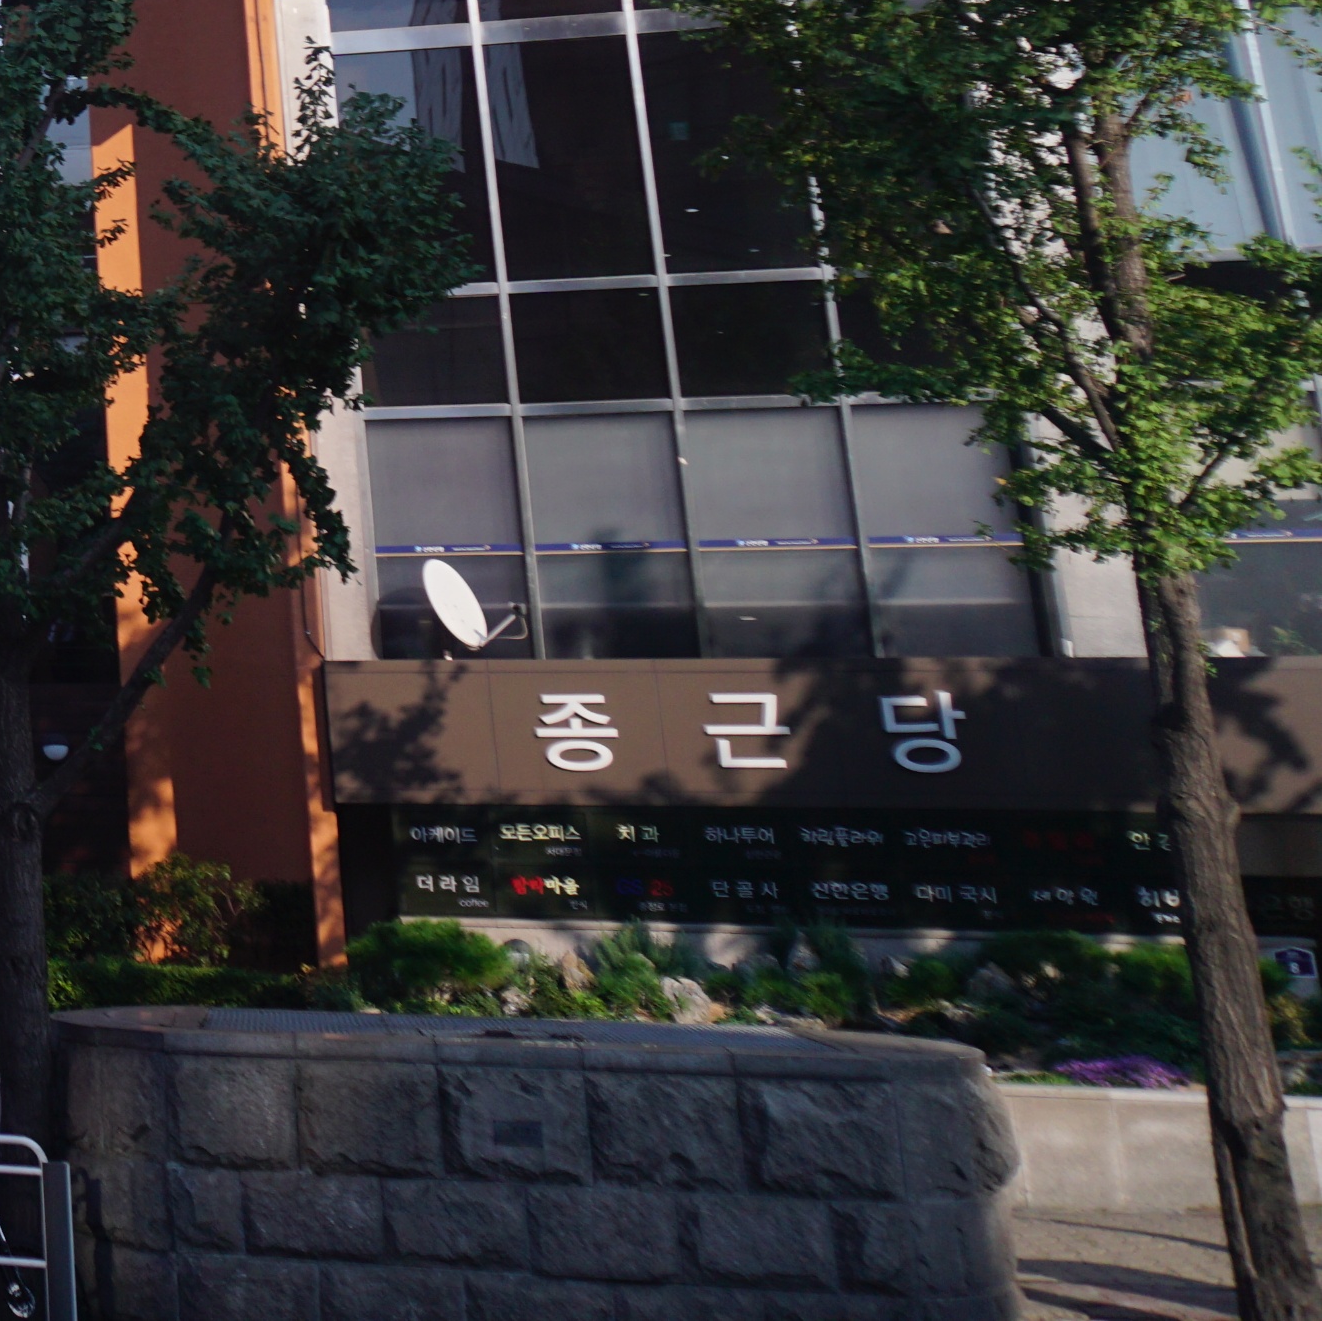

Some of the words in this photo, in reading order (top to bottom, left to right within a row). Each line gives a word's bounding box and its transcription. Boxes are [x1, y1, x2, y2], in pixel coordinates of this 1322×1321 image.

[534, 690, 965, 772] 종근당
[410, 825, 478, 844] 아케이드
[499, 823, 582, 842] 모든오피스
[615, 823, 660, 843] 치과
[703, 825, 775, 845] 하나투어
[415, 874, 480, 894] 더라임
[811, 881, 891, 901] 신한은행
